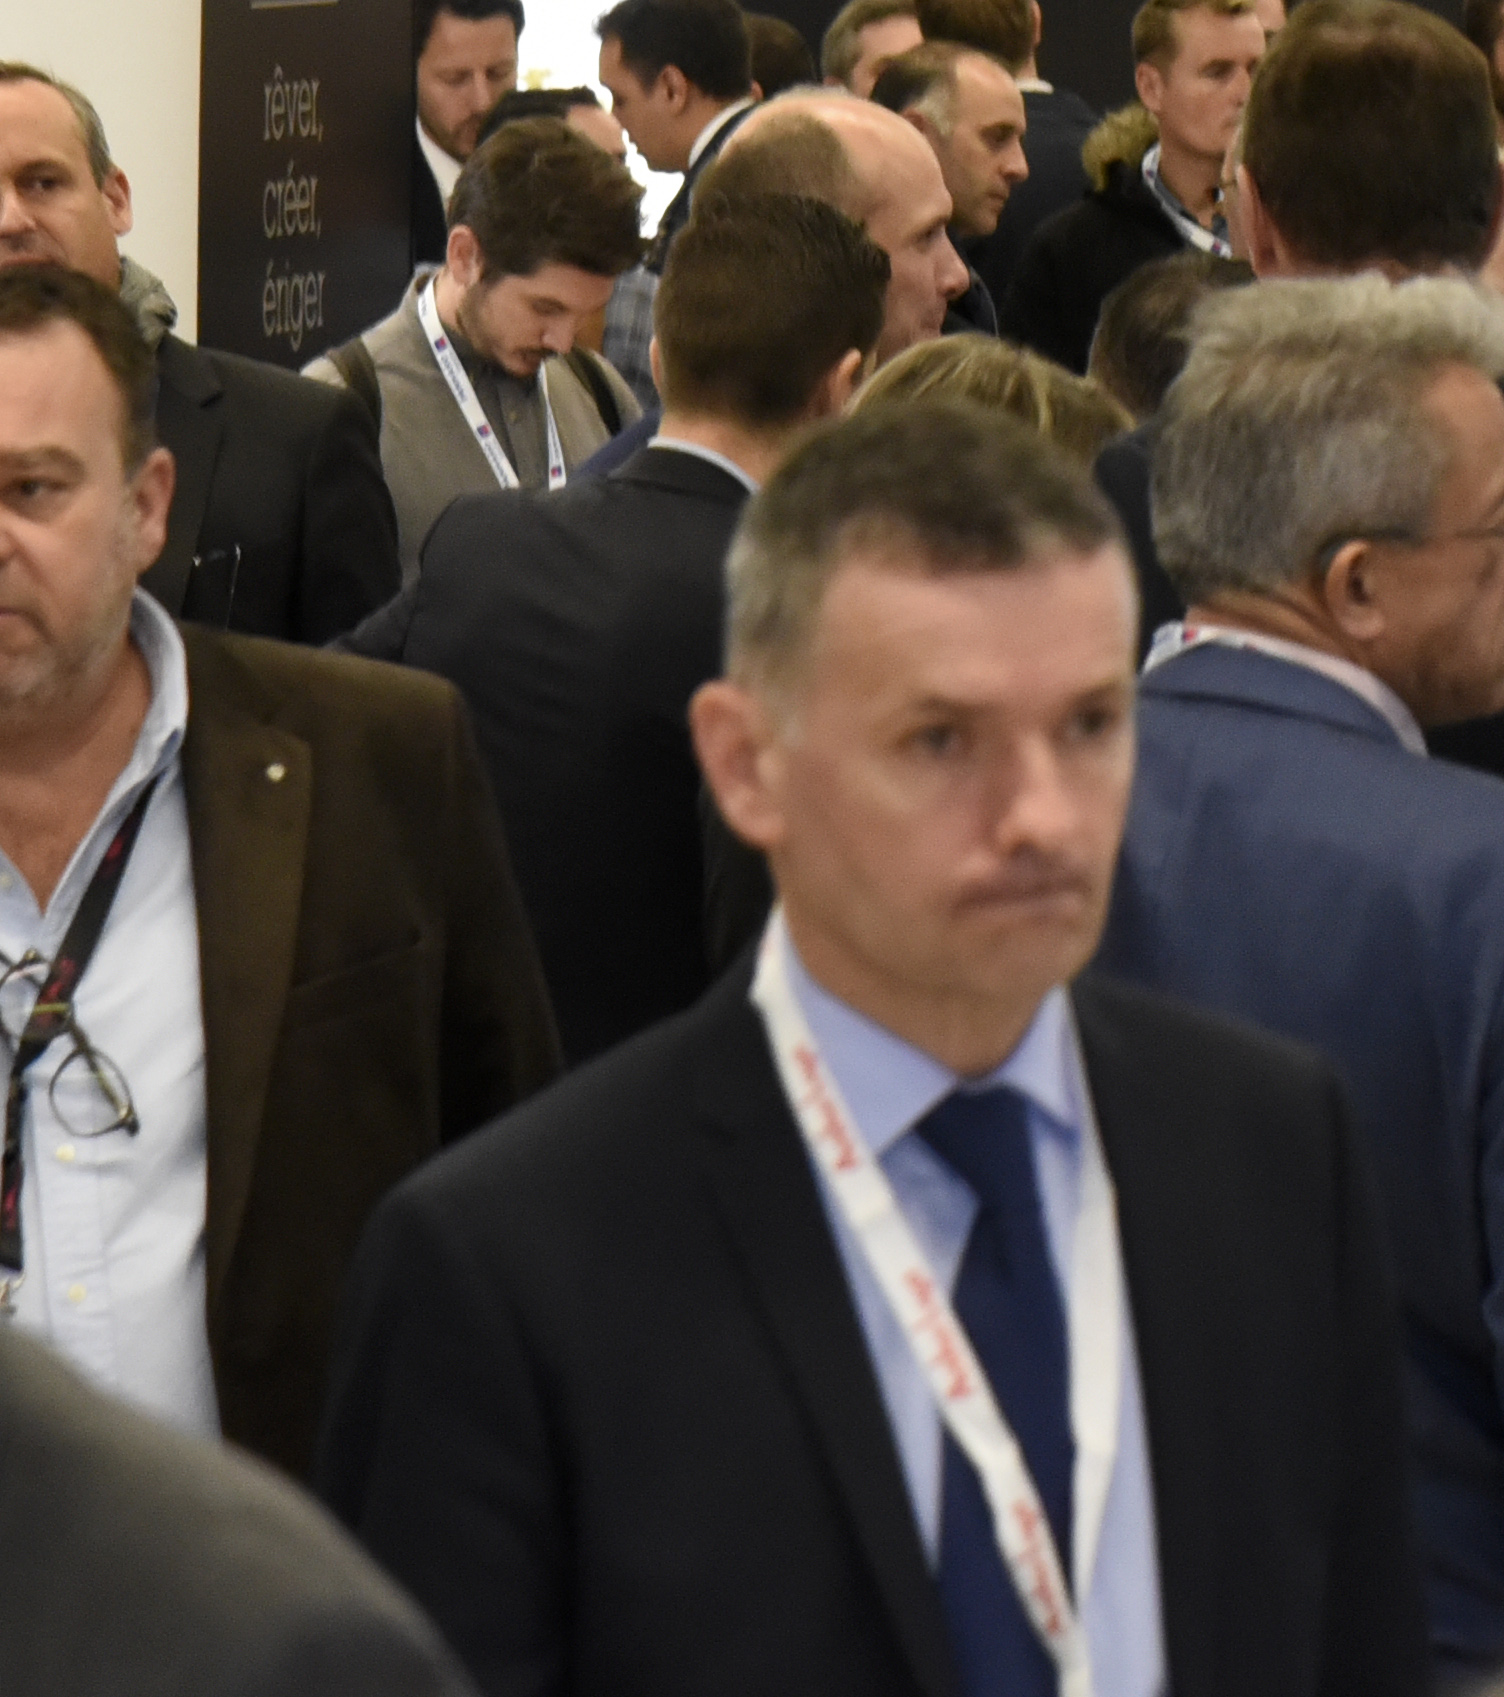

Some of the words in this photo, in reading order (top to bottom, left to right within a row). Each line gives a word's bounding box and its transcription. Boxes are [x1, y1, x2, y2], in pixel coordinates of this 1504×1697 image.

[263, 63, 324, 142] rêver,
[261, 158, 321, 240] créer,
[262, 257, 326, 353] ériger
